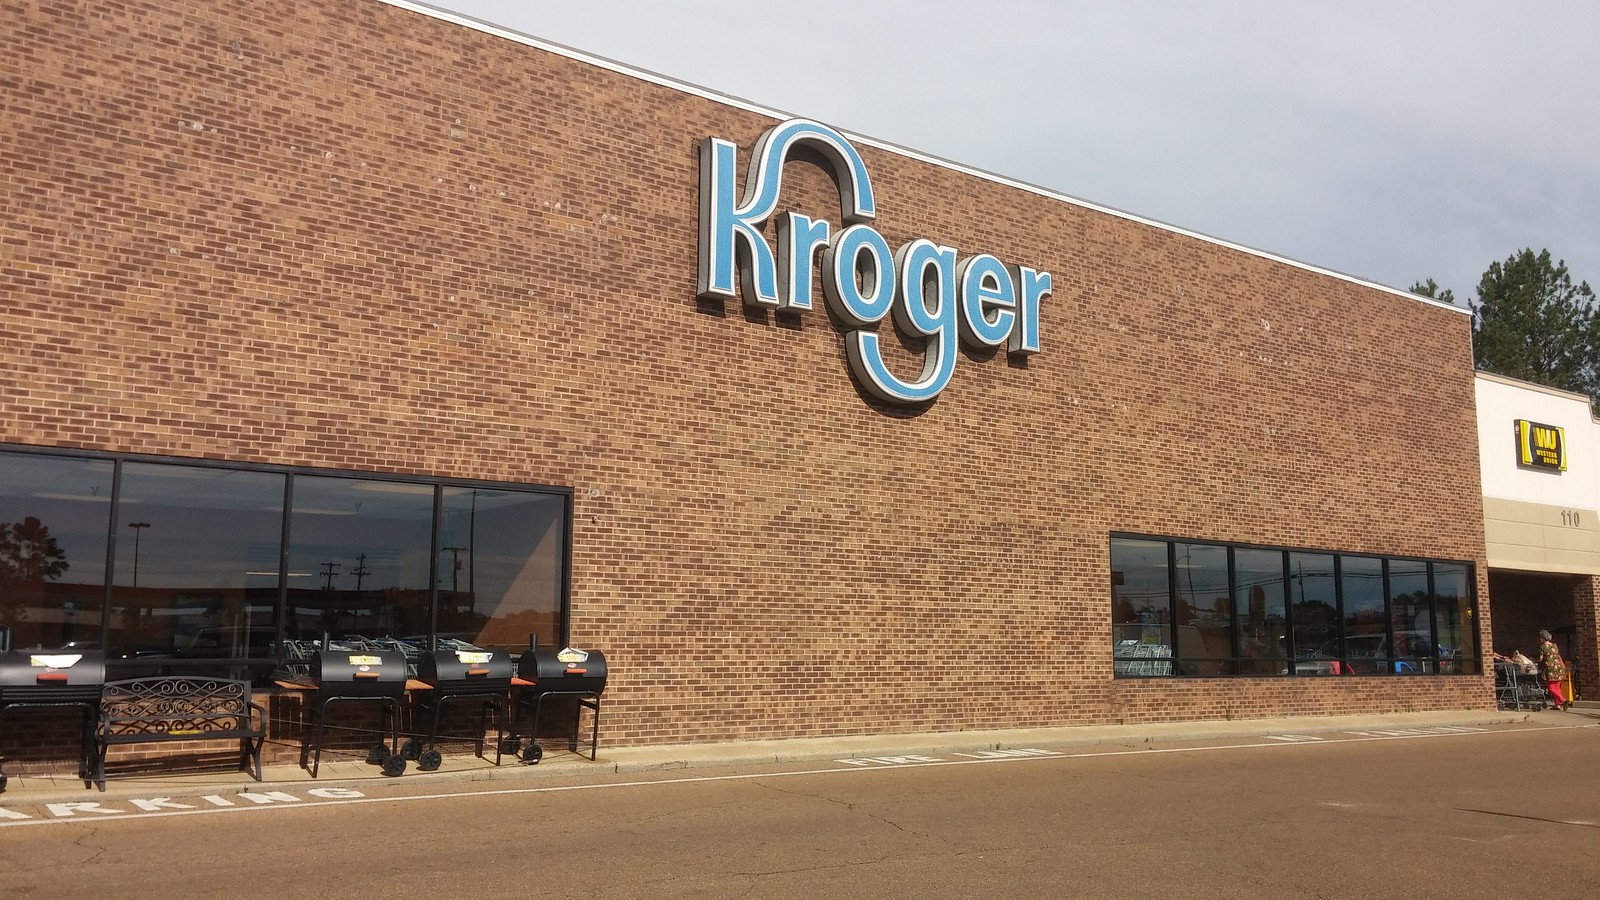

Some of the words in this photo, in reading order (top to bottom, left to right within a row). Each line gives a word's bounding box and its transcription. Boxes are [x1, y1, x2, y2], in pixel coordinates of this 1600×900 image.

[699, 118, 1052, 401] Kroger
[1533, 427, 1556, 449] WU
[1536, 449, 1557, 458] WESTERN
[1561, 510, 1580, 527] 110
[833, 754, 947, 766] FIRE
[951, 748, 1066, 759] LANE
